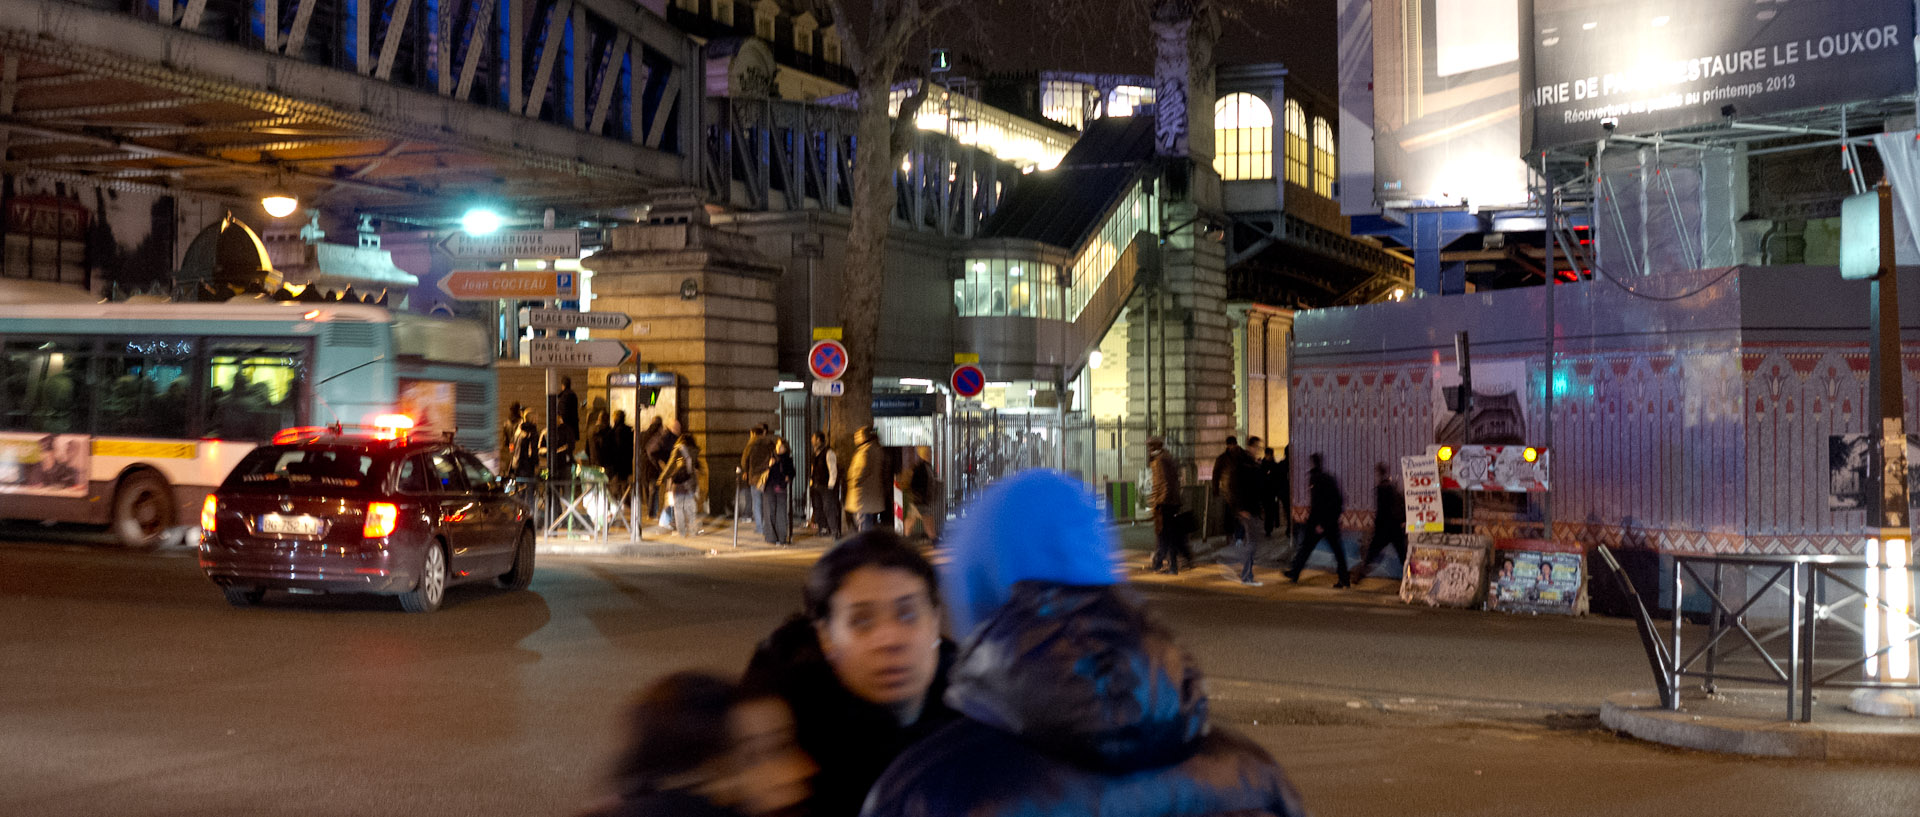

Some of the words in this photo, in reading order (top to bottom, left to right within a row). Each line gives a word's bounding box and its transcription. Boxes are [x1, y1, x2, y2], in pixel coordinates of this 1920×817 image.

[1575, 78, 1599, 101] DE
[1773, 42, 1799, 67] LE
[1806, 24, 1899, 61] LOUXOR
[1564, 102, 1630, 124] Réouverture
[1685, 92, 1700, 105] au
[1702, 82, 1763, 105] printemps
[1766, 73, 1796, 92] 2013
[491, 245, 571, 255] CLIGNANCOURT
[464, 278, 489, 289] Jean
[492, 278, 547, 290] COCTEAU
[535, 313, 562, 323] PLACE
[566, 314, 620, 325] STALINGRAD
[535, 343, 560, 352] PARC
[548, 353, 593, 363] VILLETTE
